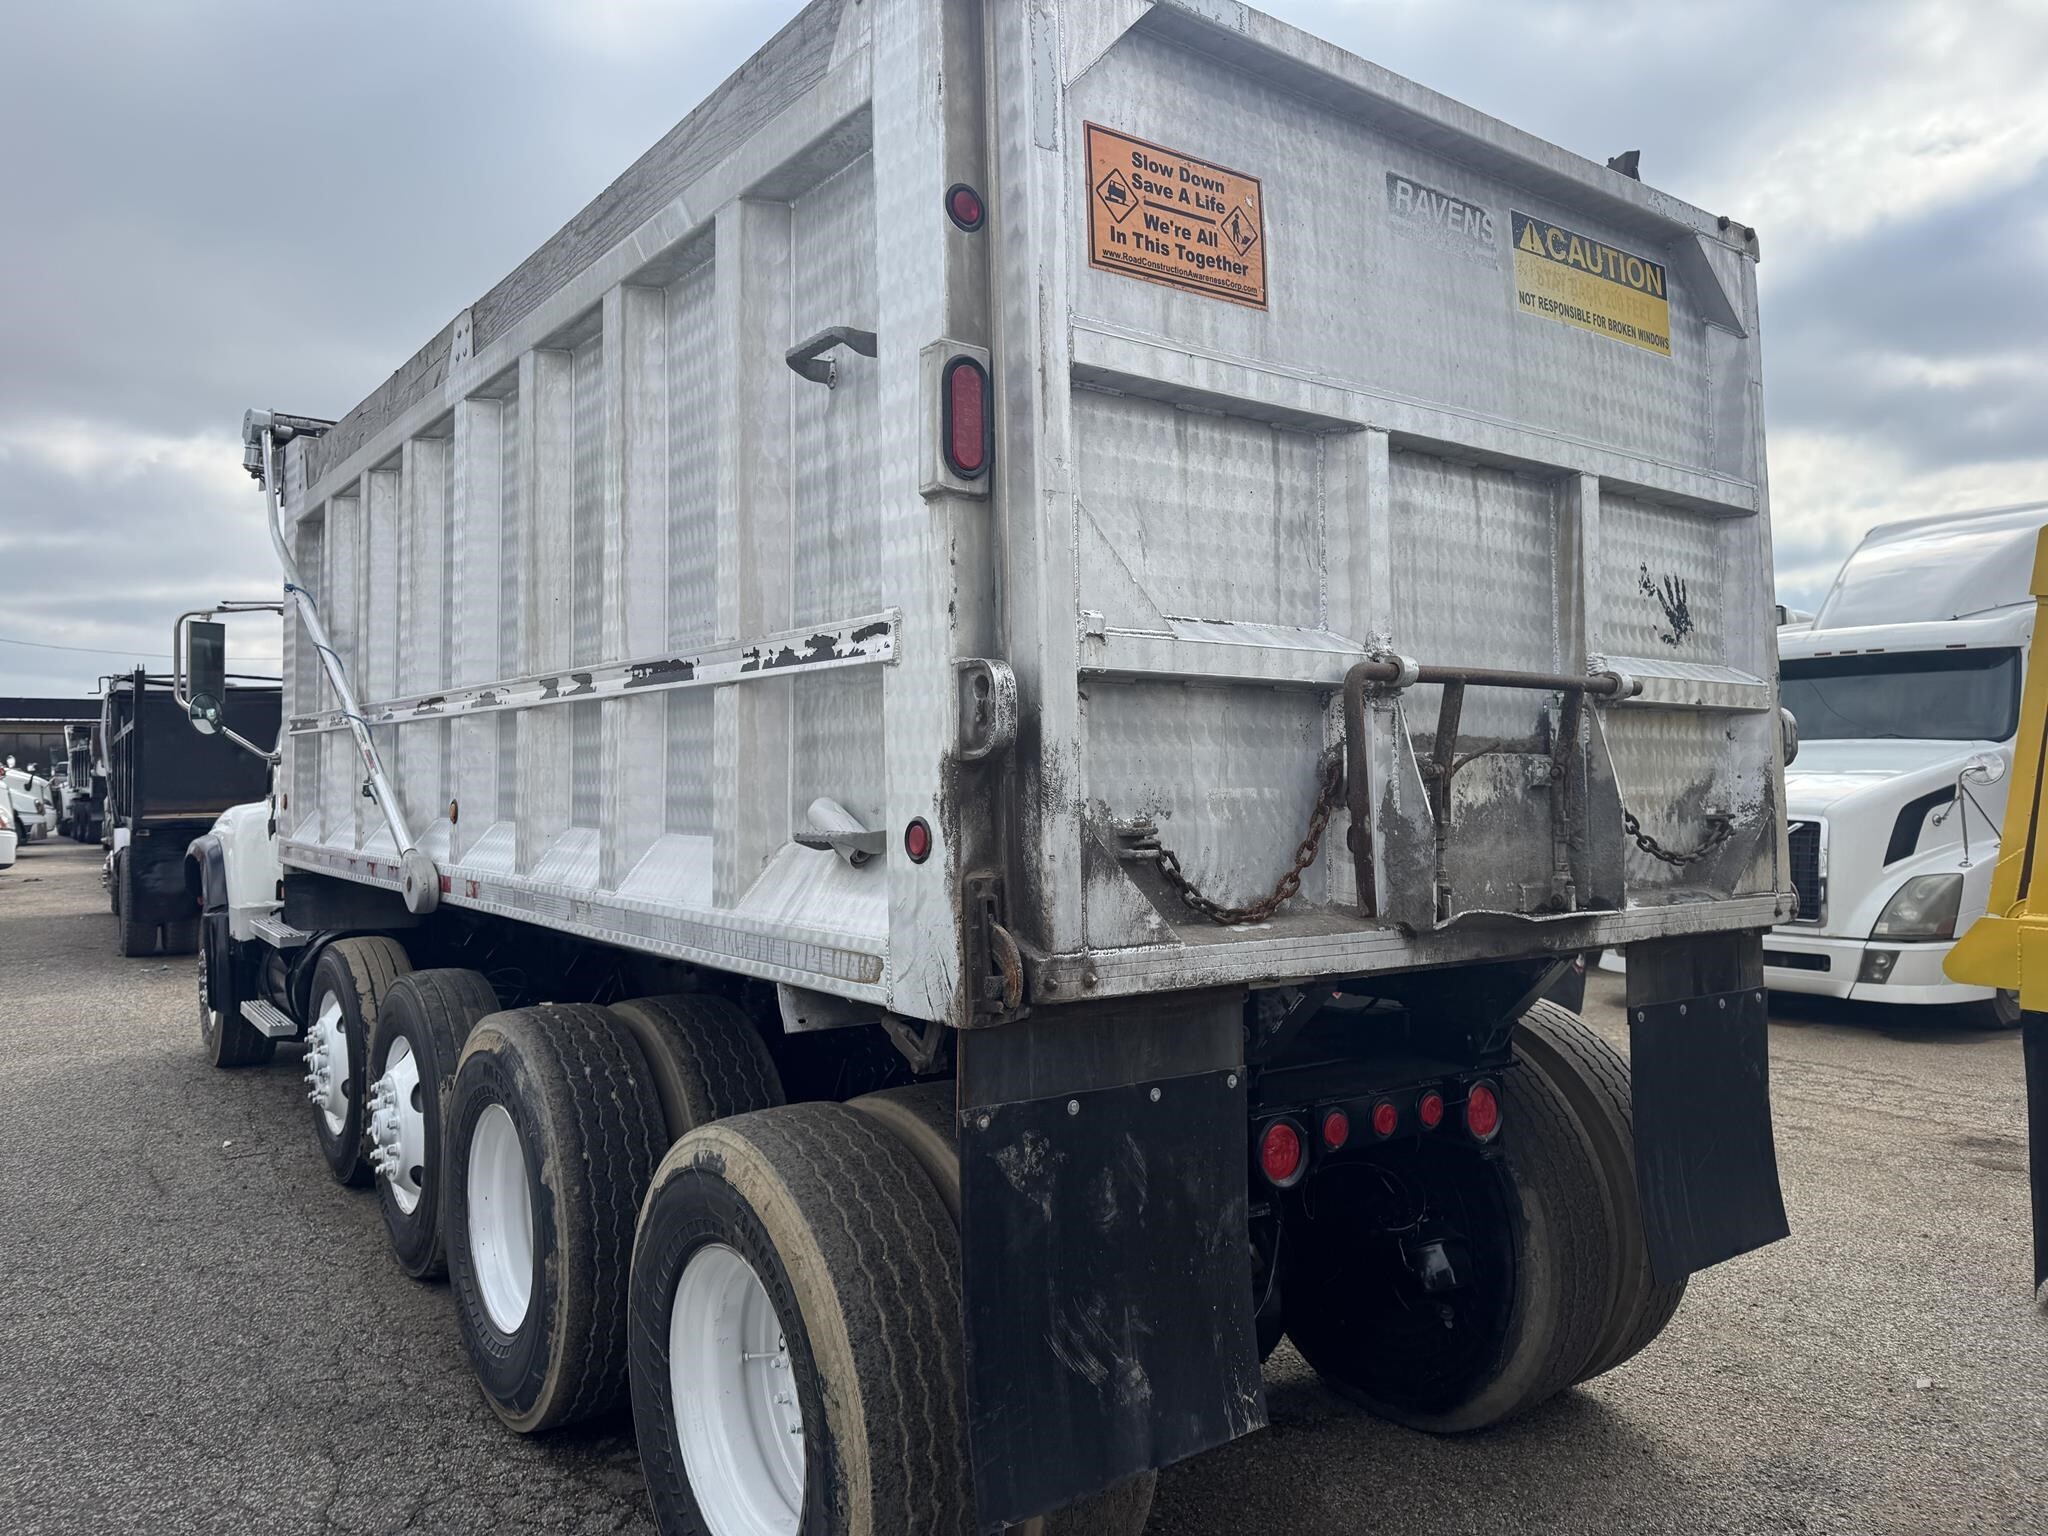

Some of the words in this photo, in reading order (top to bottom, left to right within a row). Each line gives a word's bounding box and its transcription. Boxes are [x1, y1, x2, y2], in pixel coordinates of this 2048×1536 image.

[1131, 151, 1174, 178] Slow
[1179, 166, 1225, 194] Down
[1131, 172, 1174, 199] Save
[1178, 187, 1191, 205] A
[1196, 191, 1226, 214] Life
[1143, 212, 1191, 240] We're
[1197, 229, 1218, 248] All
[1395, 179, 1494, 244] RAVENS
[1102, 248, 1258, 294] www.RoadConstructionAwarenessCorp.com
[1110, 225, 1127, 245] In
[1132, 231, 1170, 256] This
[1175, 244, 1249, 277] Together
[1546, 226, 1663, 296] CAUTION
[1519, 290, 1536, 308] NOT
[1538, 296, 1592, 325] RESPONSIBLE
[1592, 313, 1607, 329] FOR
[1608, 318, 1637, 339] BROKEN
[1637, 327, 1670, 350] WINDOWS
